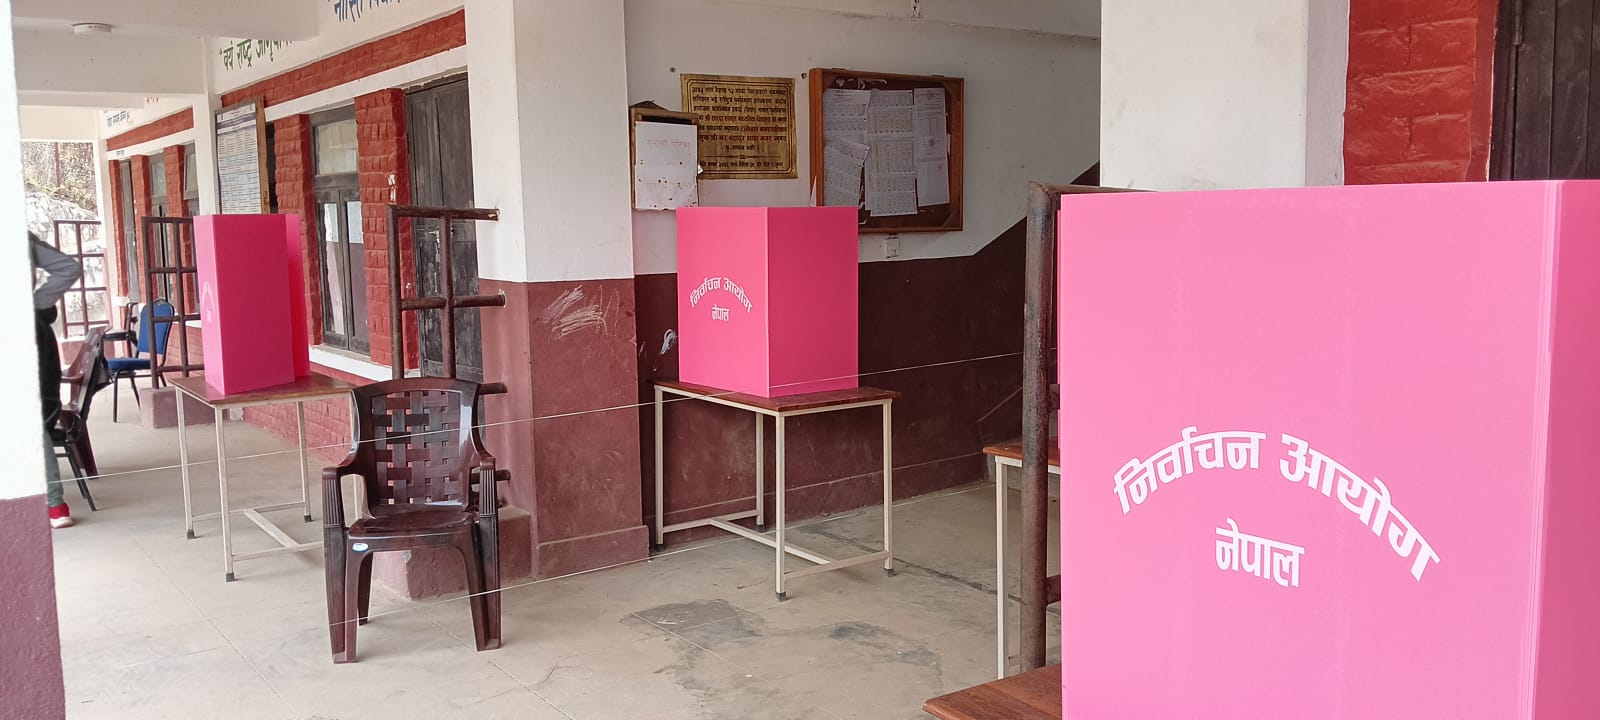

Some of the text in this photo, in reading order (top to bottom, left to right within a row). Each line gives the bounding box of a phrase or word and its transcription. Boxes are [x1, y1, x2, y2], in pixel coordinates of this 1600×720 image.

[689, 276, 753, 313] निर्वाचन आयोग
[711, 304, 730, 322] नेपाल
[1113, 426, 1441, 582] निर्वाचन आयोग
[1215, 517, 1305, 588] नेपाल
